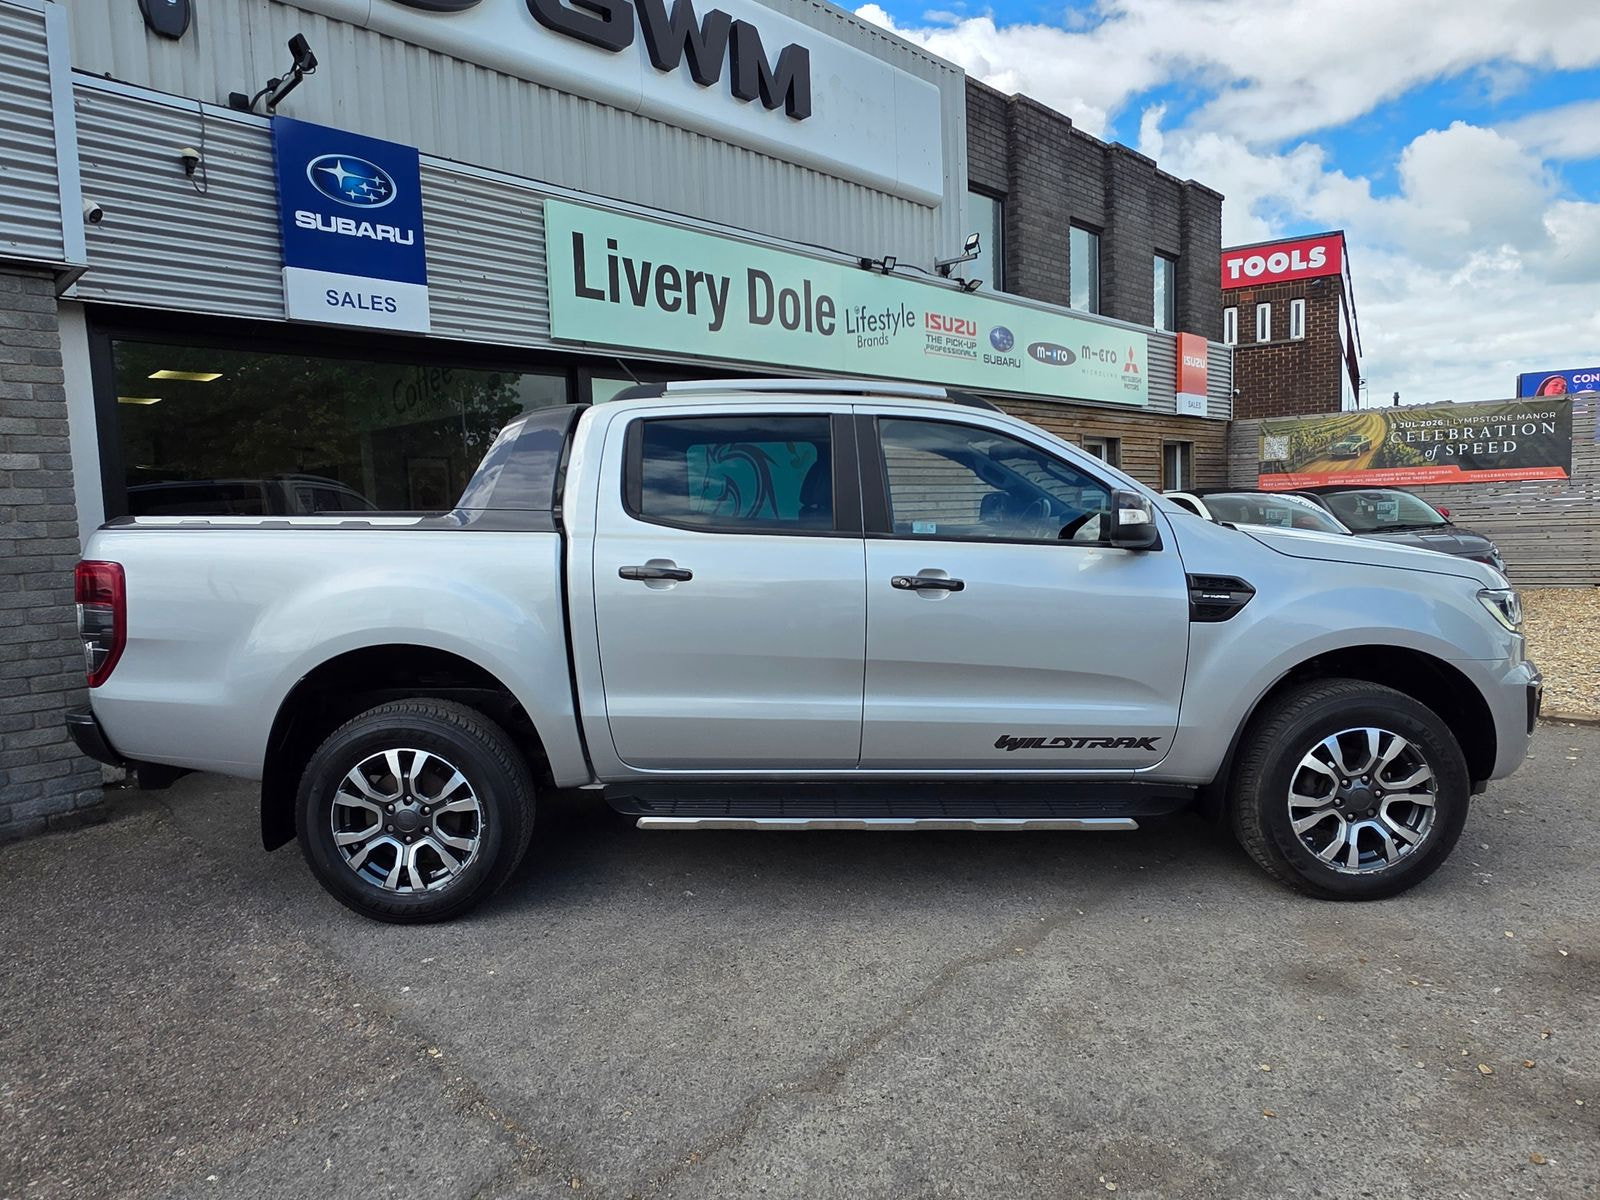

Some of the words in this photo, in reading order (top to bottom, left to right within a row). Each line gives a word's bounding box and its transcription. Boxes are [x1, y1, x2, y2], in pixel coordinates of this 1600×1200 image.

[294, 210, 415, 246] SUBARU
[1227, 246, 1327, 279] TOOLS
[572, 231, 730, 332] Livery
[747, 267, 836, 336] Dole
[326, 290, 397, 313] SALES
[845, 302, 916, 336] Lifestyle
[925, 312, 977, 337] ISUZU
[857, 332, 889, 349] Brands
[925, 334, 943, 345] THE
[945, 337, 977, 350] PICK-UP
[925, 344, 977, 358] PROFESSIONALS
[983, 353, 1021, 369] SUBARU
[1183, 355, 1207, 369] ISUZU
[1187, 400, 1202, 410] SALES
[1400, 420, 1417, 429] JUL
[1420, 419, 1444, 427] 2026
[1452, 414, 1513, 426] LYMPSTONE
[1516, 411, 1557, 421] MANOR
[1390, 421, 1556, 444] CELEBRATION
[1424, 444, 1441, 462] of
[1445, 440, 1517, 457] SPEED
[994, 735, 1162, 751] WILDTRAK
